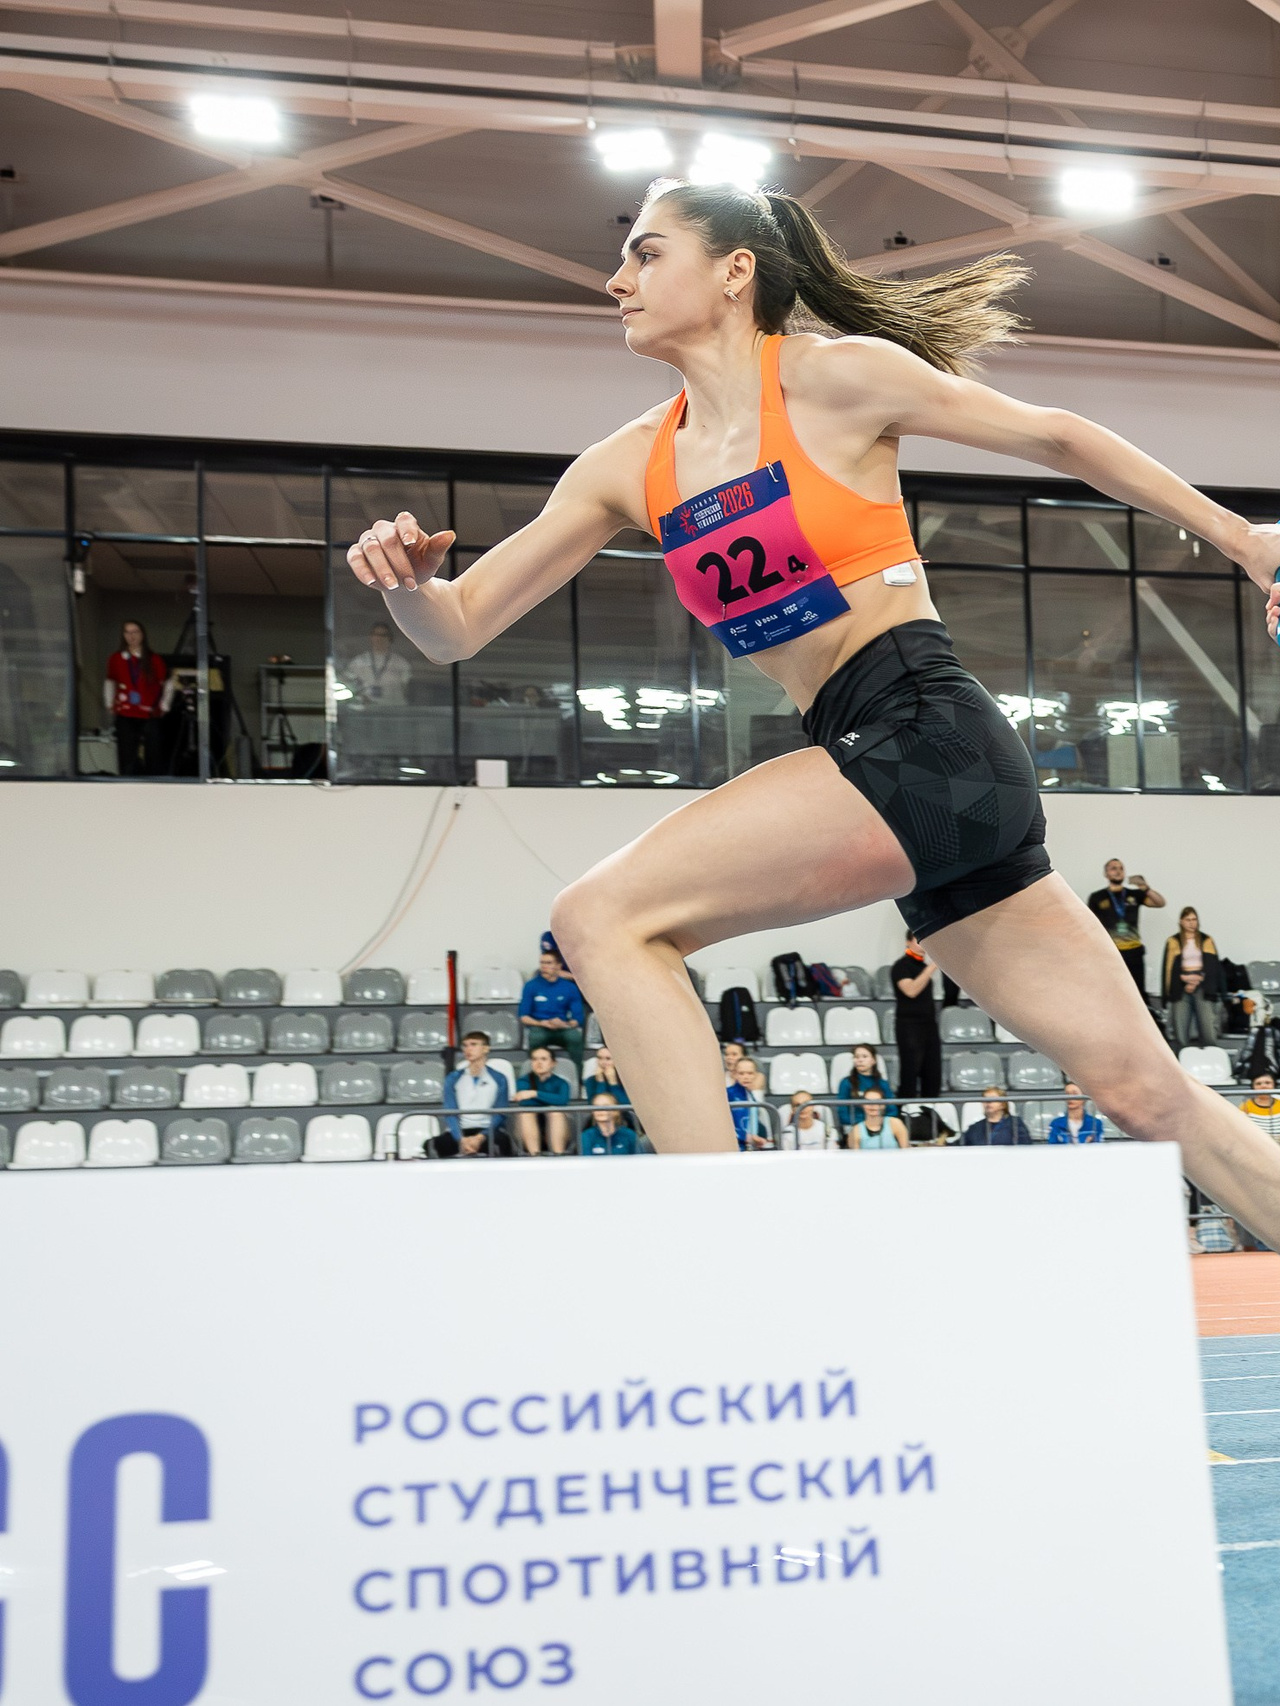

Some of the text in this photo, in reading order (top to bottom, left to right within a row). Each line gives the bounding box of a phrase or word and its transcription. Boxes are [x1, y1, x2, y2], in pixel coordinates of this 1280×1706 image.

[718, 482, 755, 518] 2026
[696, 536, 806, 605] 22 4
[354, 1368, 858, 1445] РОССИЙСКИЙ
[352, 1442, 936, 1529] СТУДЕНЧЕСКИЙ
[352, 1526, 881, 1614] СПОРТИВНЫЙ
[353, 1641, 577, 1701] СОЮЗ
